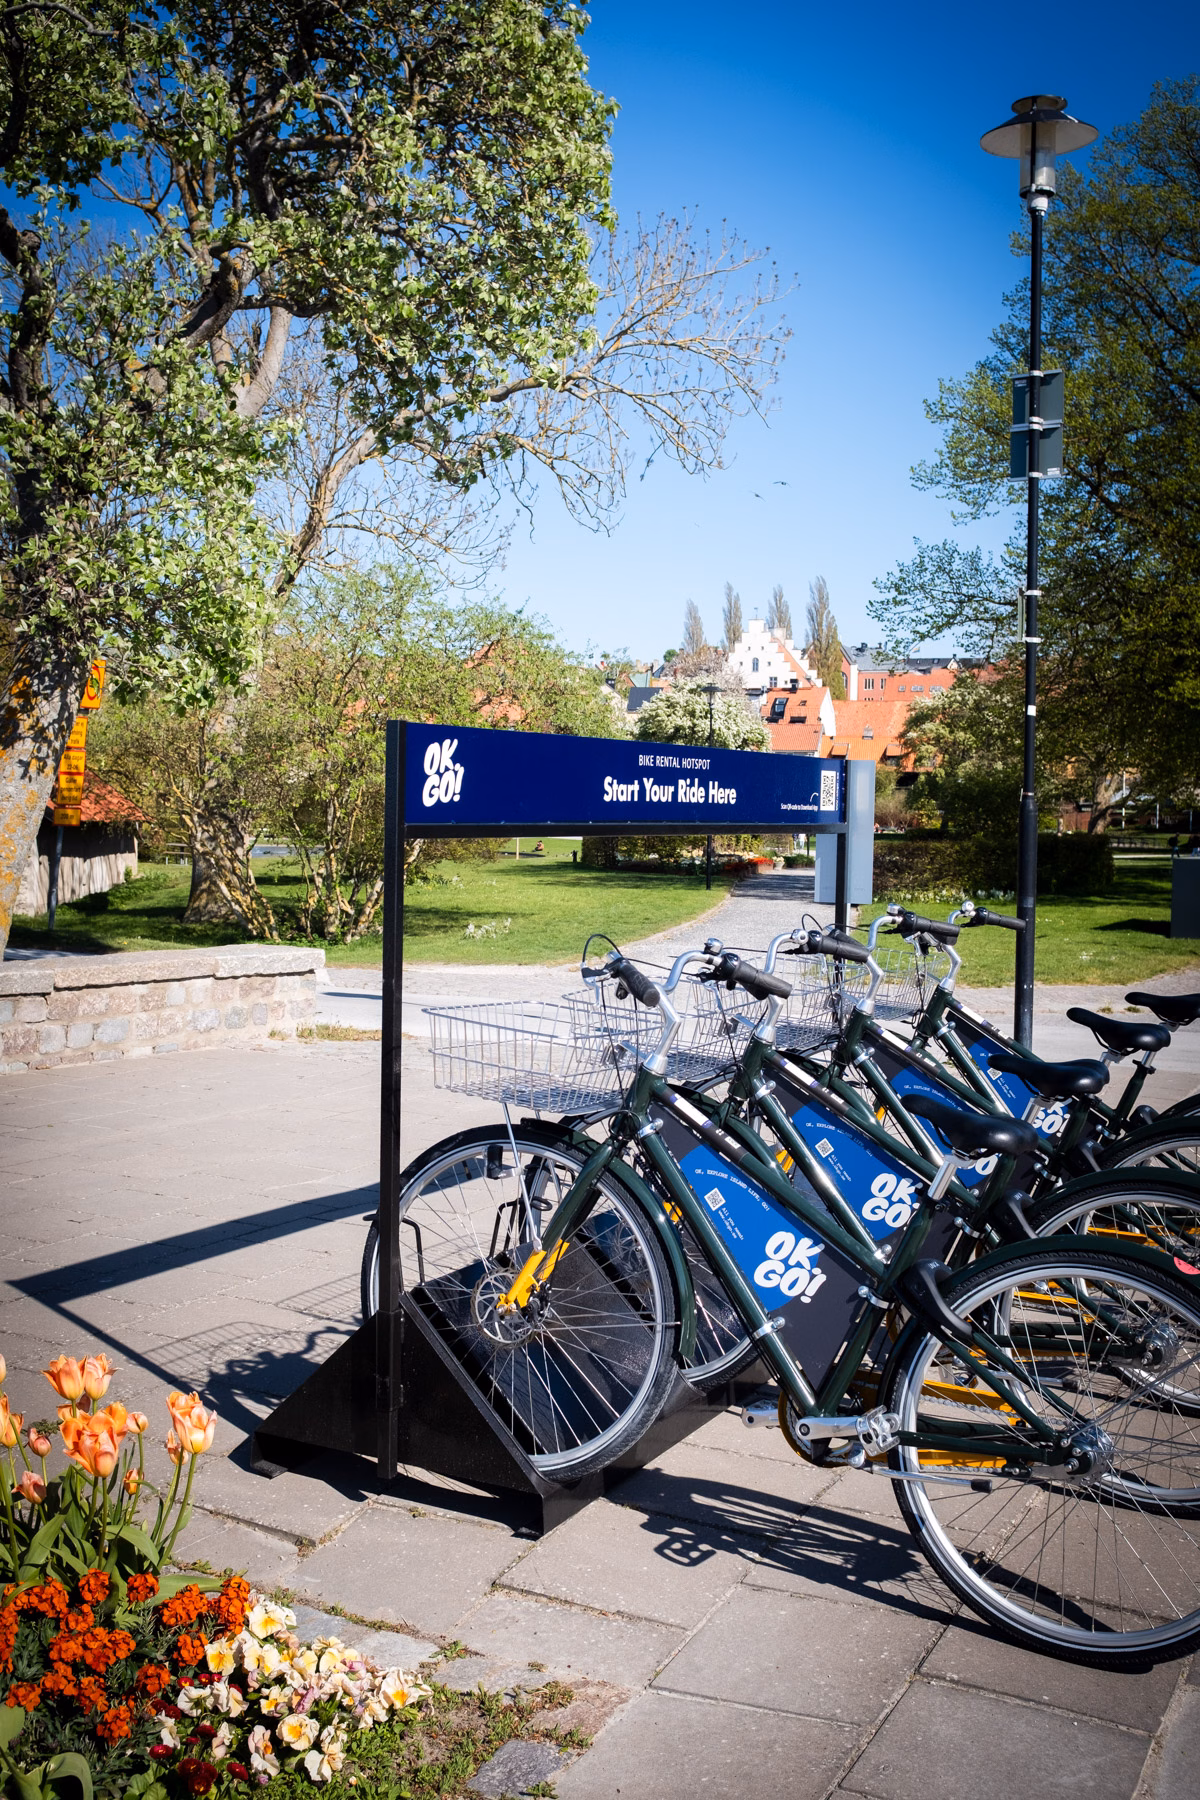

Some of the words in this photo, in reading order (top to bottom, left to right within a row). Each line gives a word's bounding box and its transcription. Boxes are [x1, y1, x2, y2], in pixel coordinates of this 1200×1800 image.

[638, 754, 654, 767] BIKE
[656, 755, 680, 768] RENTAL
[682, 758, 711, 770] HOTSPOT
[422, 765, 465, 807] GO!
[603, 775, 640, 802] Start
[642, 777, 675, 803] Your
[677, 778, 706, 804] Ride
[708, 780, 737, 805] Here
[694, 1168, 705, 1176] OK,
[706, 1168, 729, 1179] EXPLORE
[729, 1175, 748, 1190] ISLAND
[747, 1187, 761, 1202] LIFE,
[761, 1201, 771, 1213] GO!
[721, 1207, 730, 1217] All
[727, 1217, 736, 1227] you
[861, 1196, 918, 1232] GO
[753, 1259, 828, 1304] GO!
